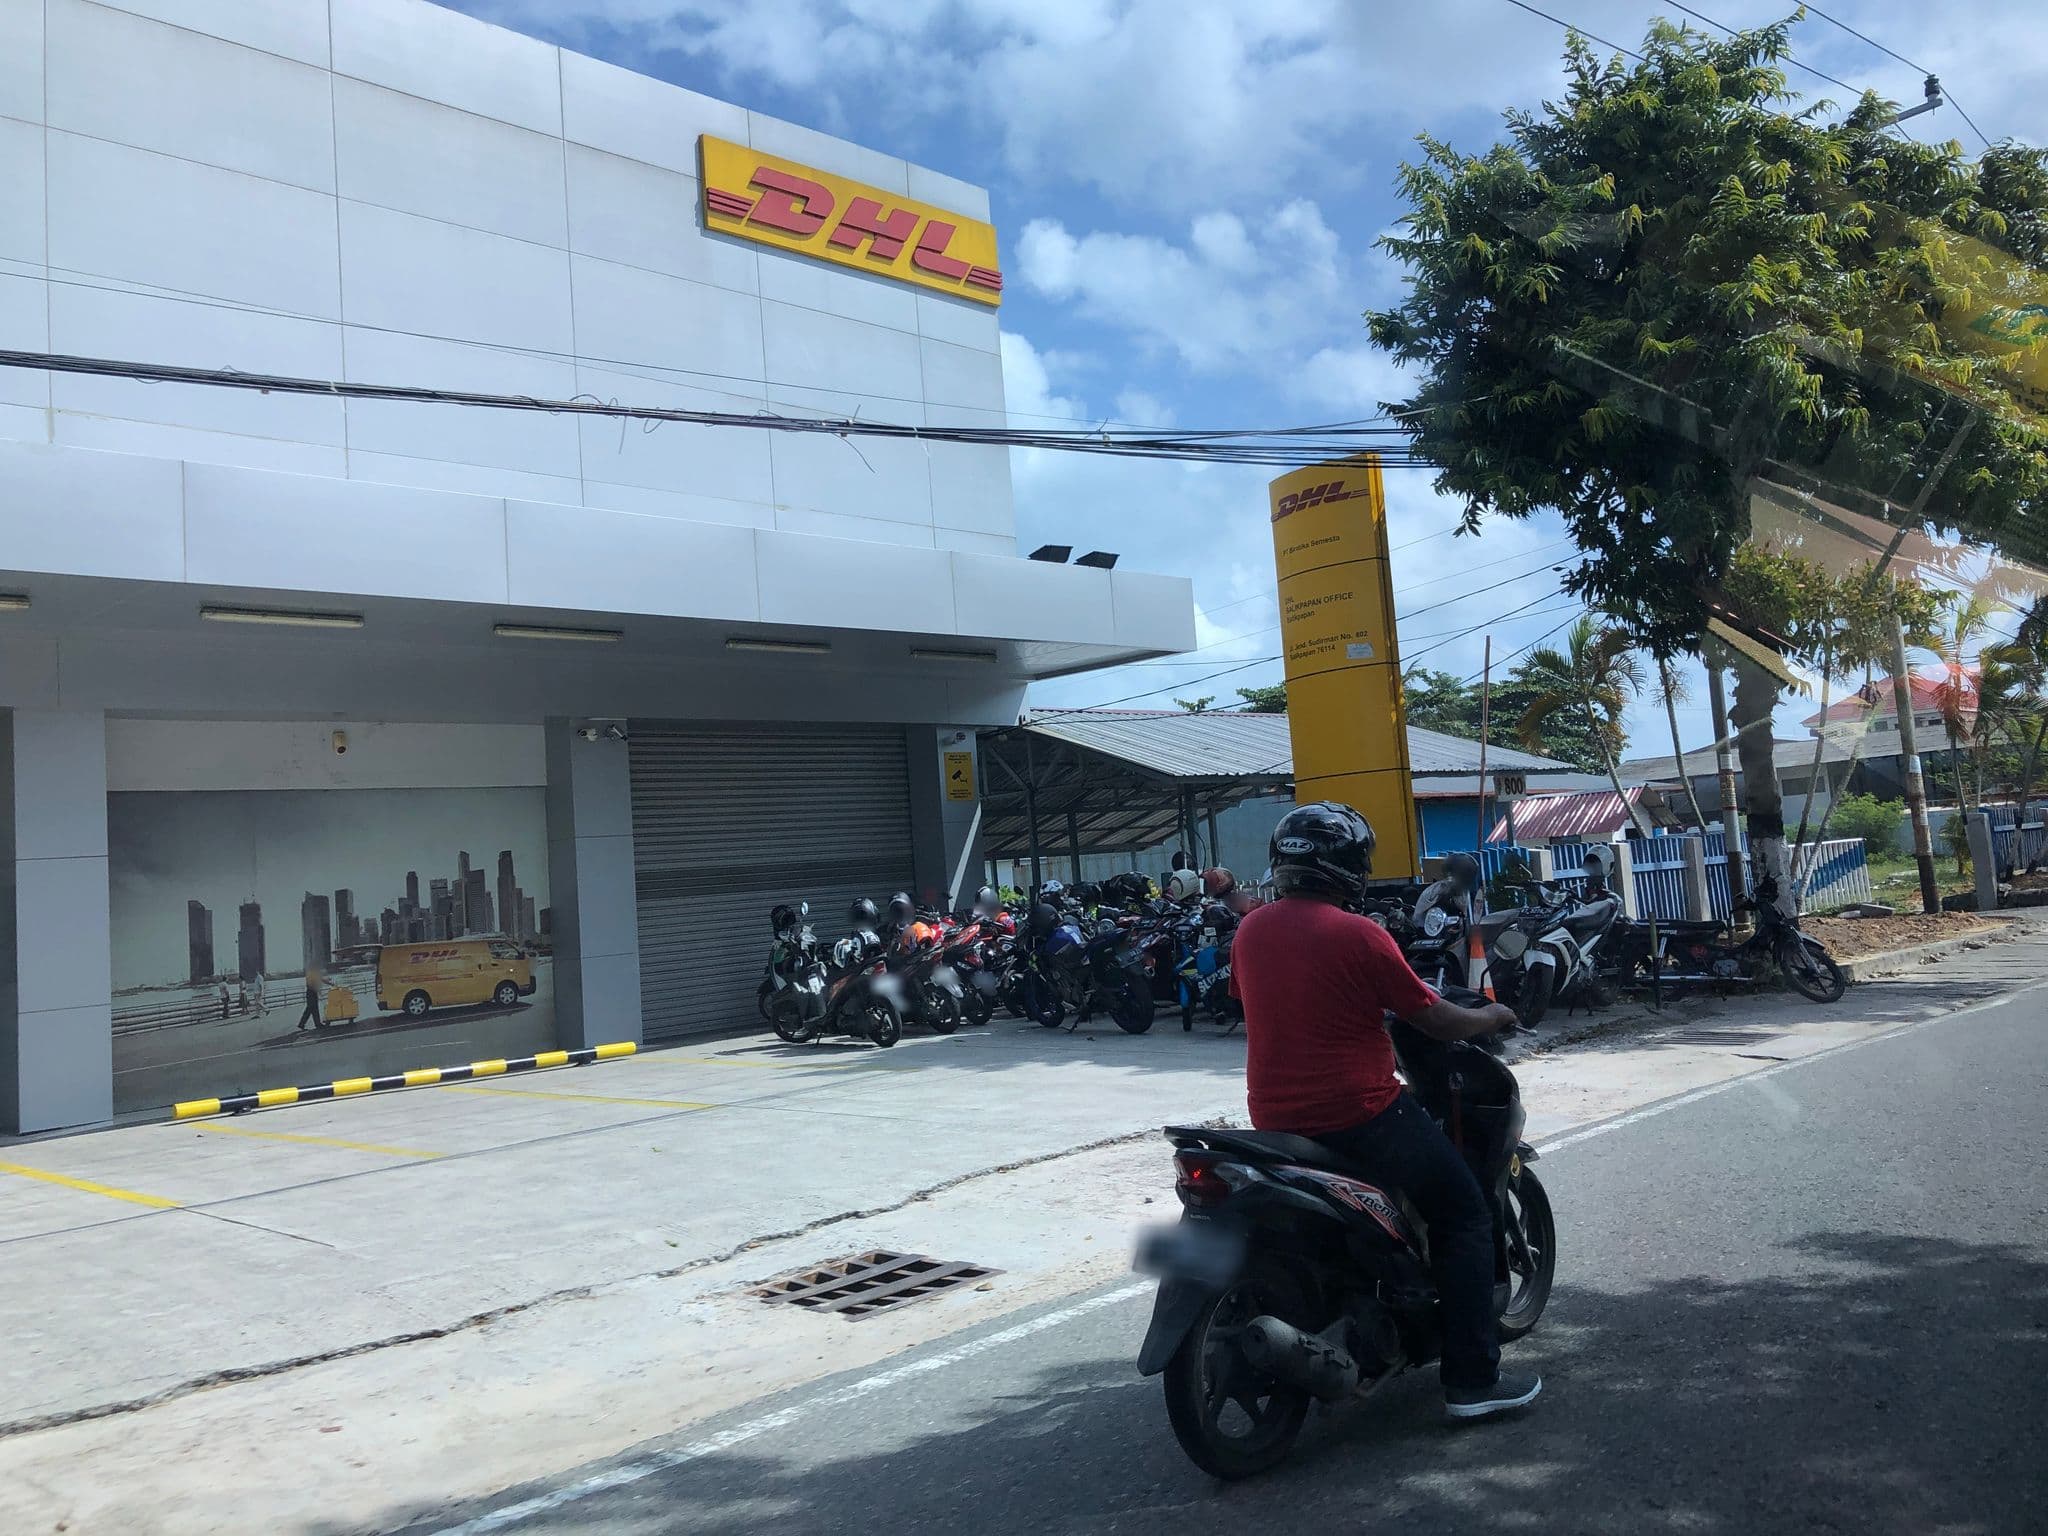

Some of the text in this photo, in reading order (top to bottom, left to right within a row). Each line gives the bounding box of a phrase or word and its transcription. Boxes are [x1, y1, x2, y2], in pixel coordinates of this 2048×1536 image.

[746, 166, 970, 280] DHL
[1276, 481, 1351, 518] DHL
[1323, 591, 1353, 604] OFFICE
[1504, 777, 1523, 795] 800
